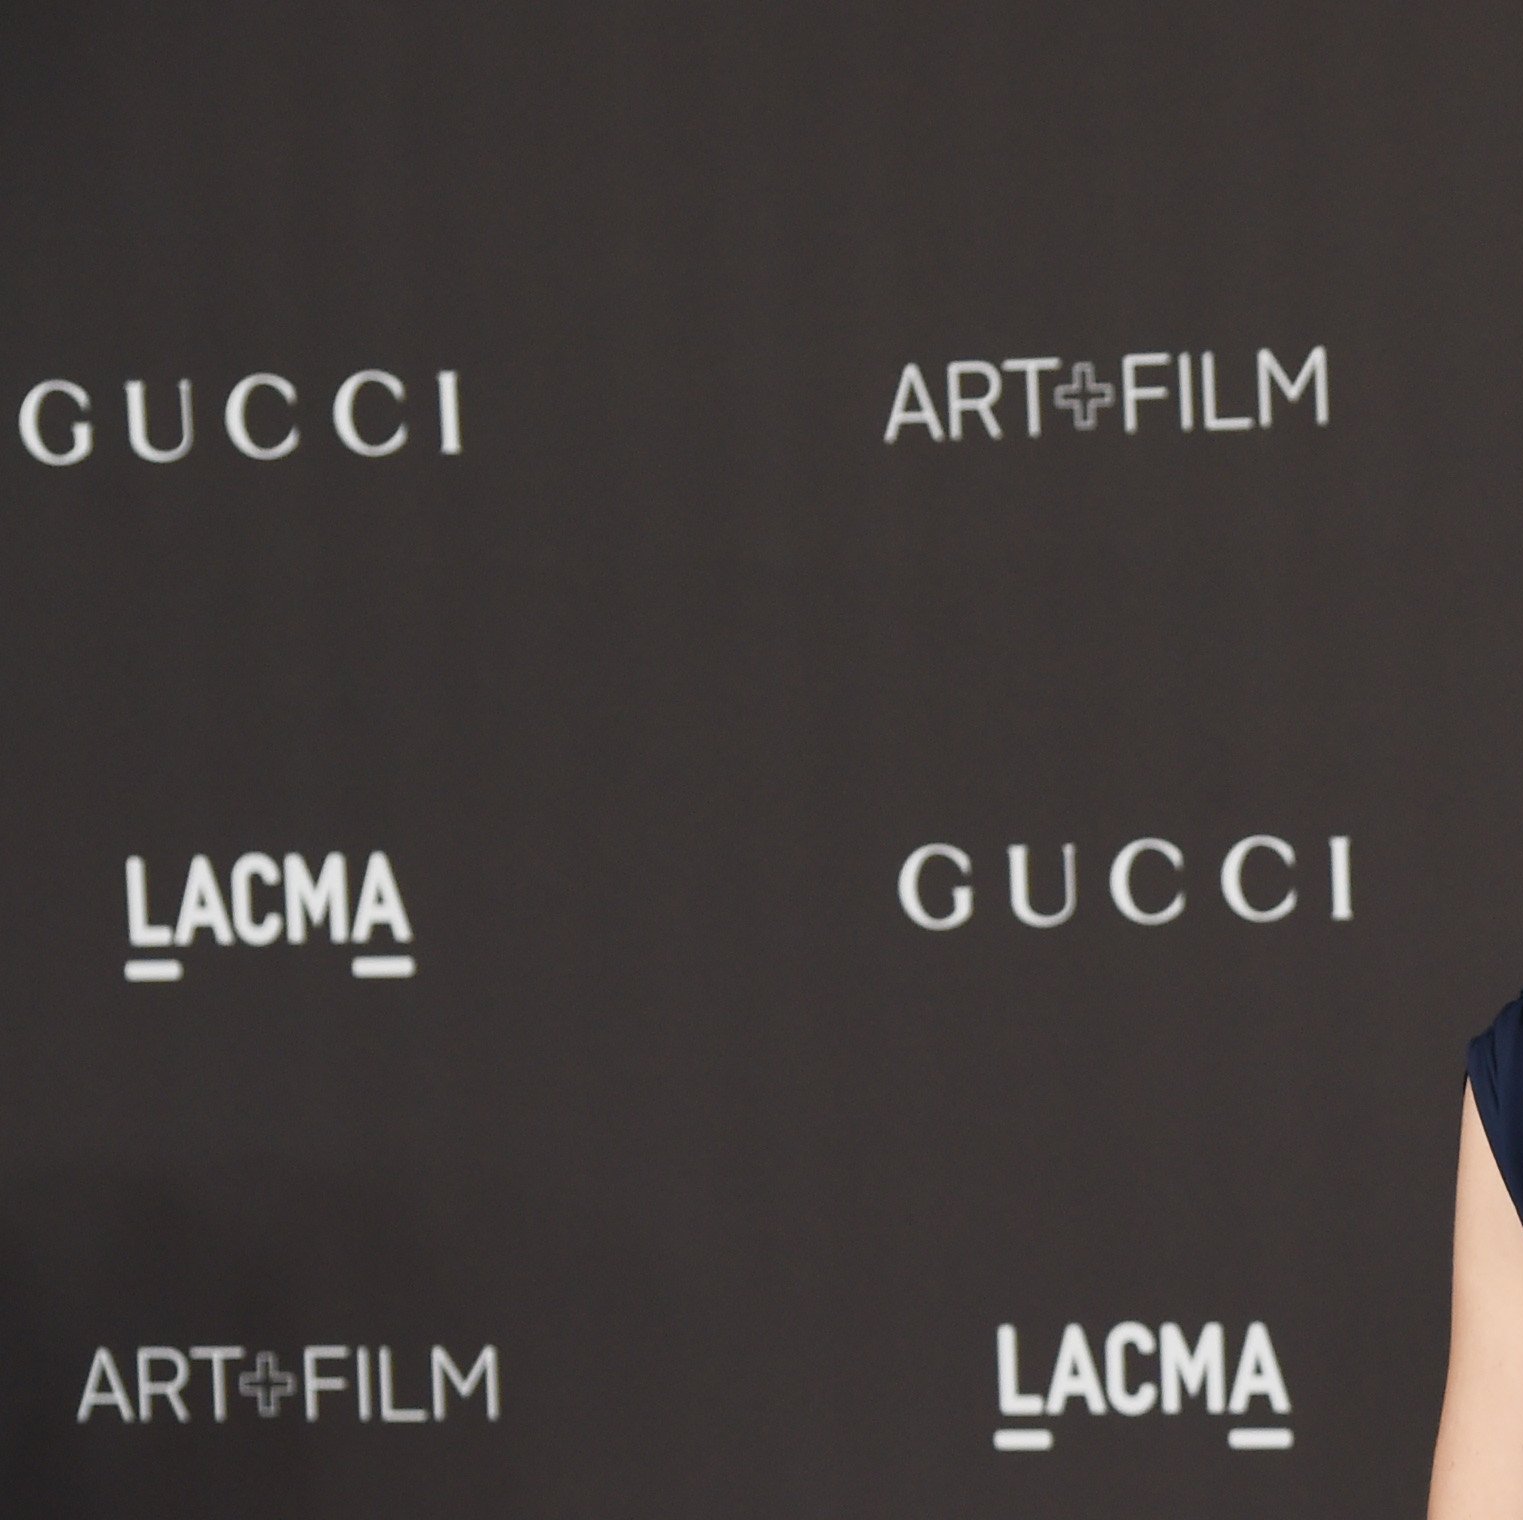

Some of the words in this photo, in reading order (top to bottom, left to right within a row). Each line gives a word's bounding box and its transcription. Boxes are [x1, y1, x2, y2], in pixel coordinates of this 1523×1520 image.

[18, 369, 462, 466] GUCCI
[883, 345, 1329, 444] ART+FILM
[125, 850, 413, 948] LACMA
[897, 834, 1353, 931] GUCCI
[77, 1344, 500, 1423] ART+FILM
[996, 1321, 1292, 1417] LACMA
